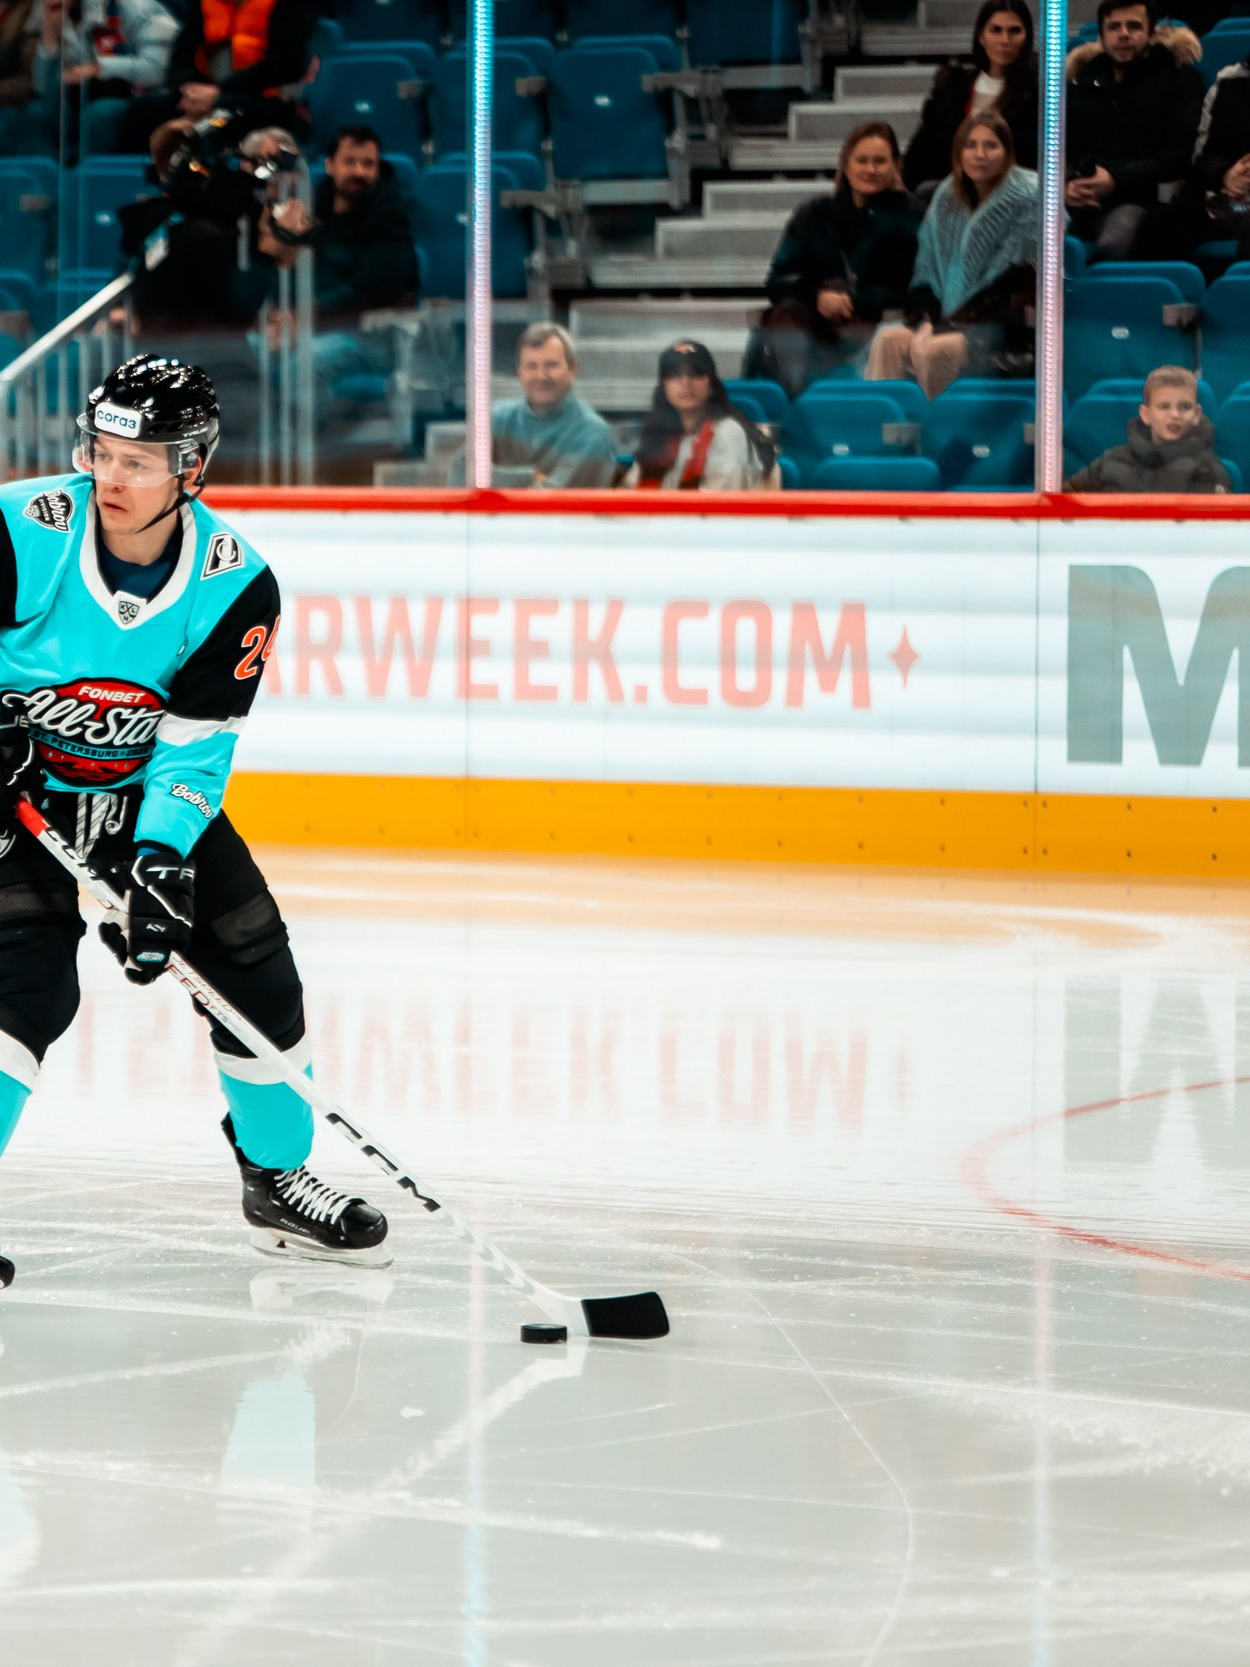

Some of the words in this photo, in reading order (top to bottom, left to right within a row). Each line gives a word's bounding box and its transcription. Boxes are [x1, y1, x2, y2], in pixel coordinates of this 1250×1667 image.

[96, 410, 137, 430] согаз
[263, 592, 872, 709] RWEEK.COM
[78, 685, 147, 703] FONBET
[1, 689, 165, 746] All-Sta
[50, 736, 119, 758] PETERSBURG
[171, 783, 213, 819] Bobrov
[146, 866, 195, 880] TR
